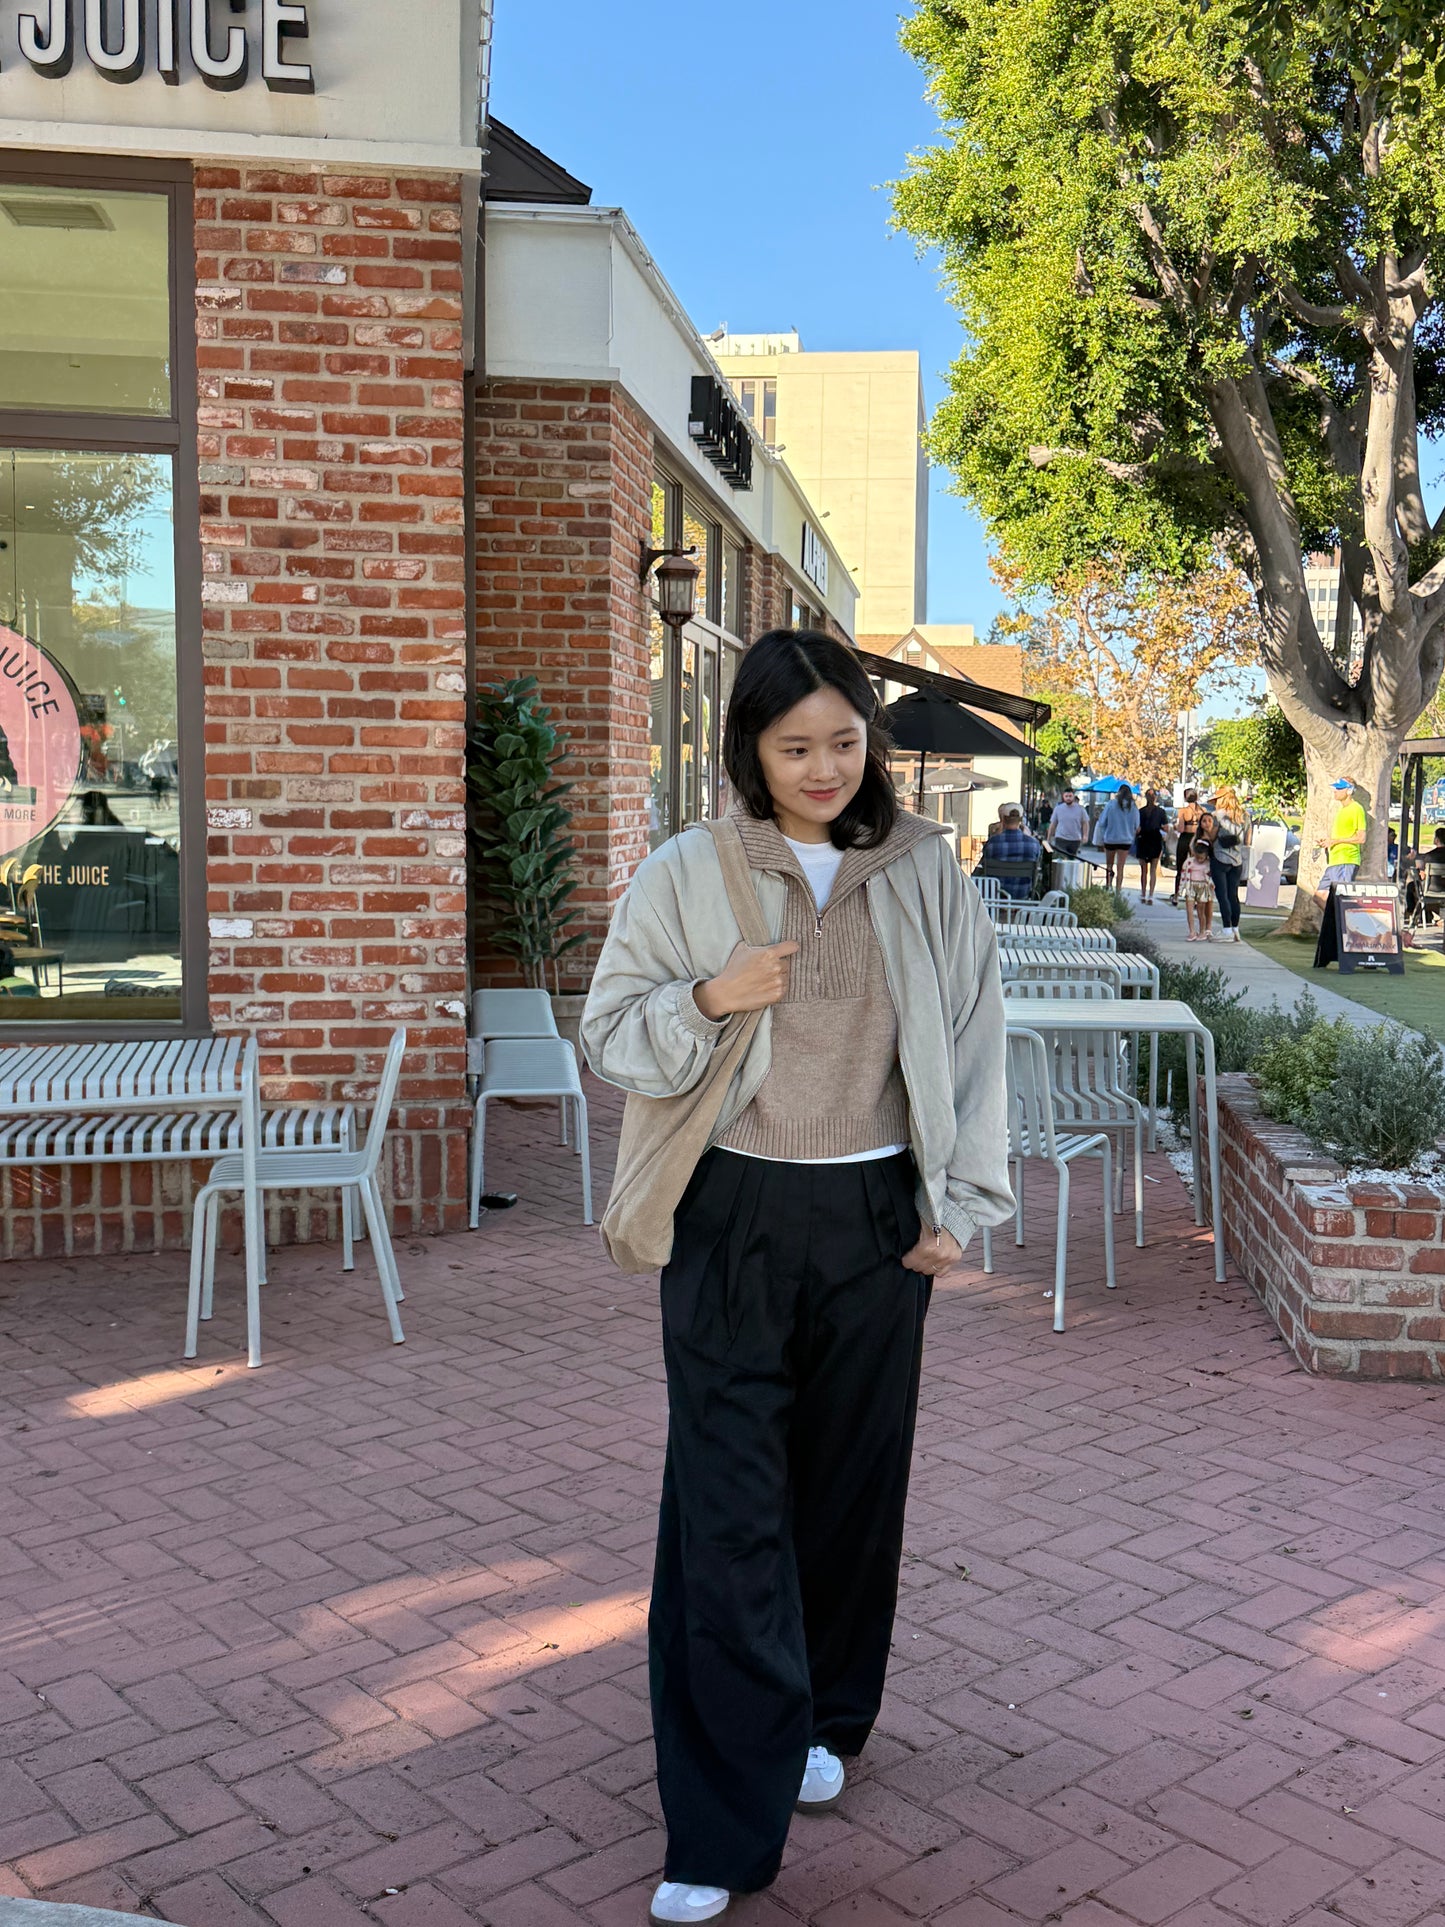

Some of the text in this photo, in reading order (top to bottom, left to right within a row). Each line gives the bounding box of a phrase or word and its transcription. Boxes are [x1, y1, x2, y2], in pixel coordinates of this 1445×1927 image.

[930, 784, 954, 792] VALET
[4, 808, 36, 821] MORE
[67, 865, 110, 886] JUICE
[1335, 884, 1399, 897] ALFRED
